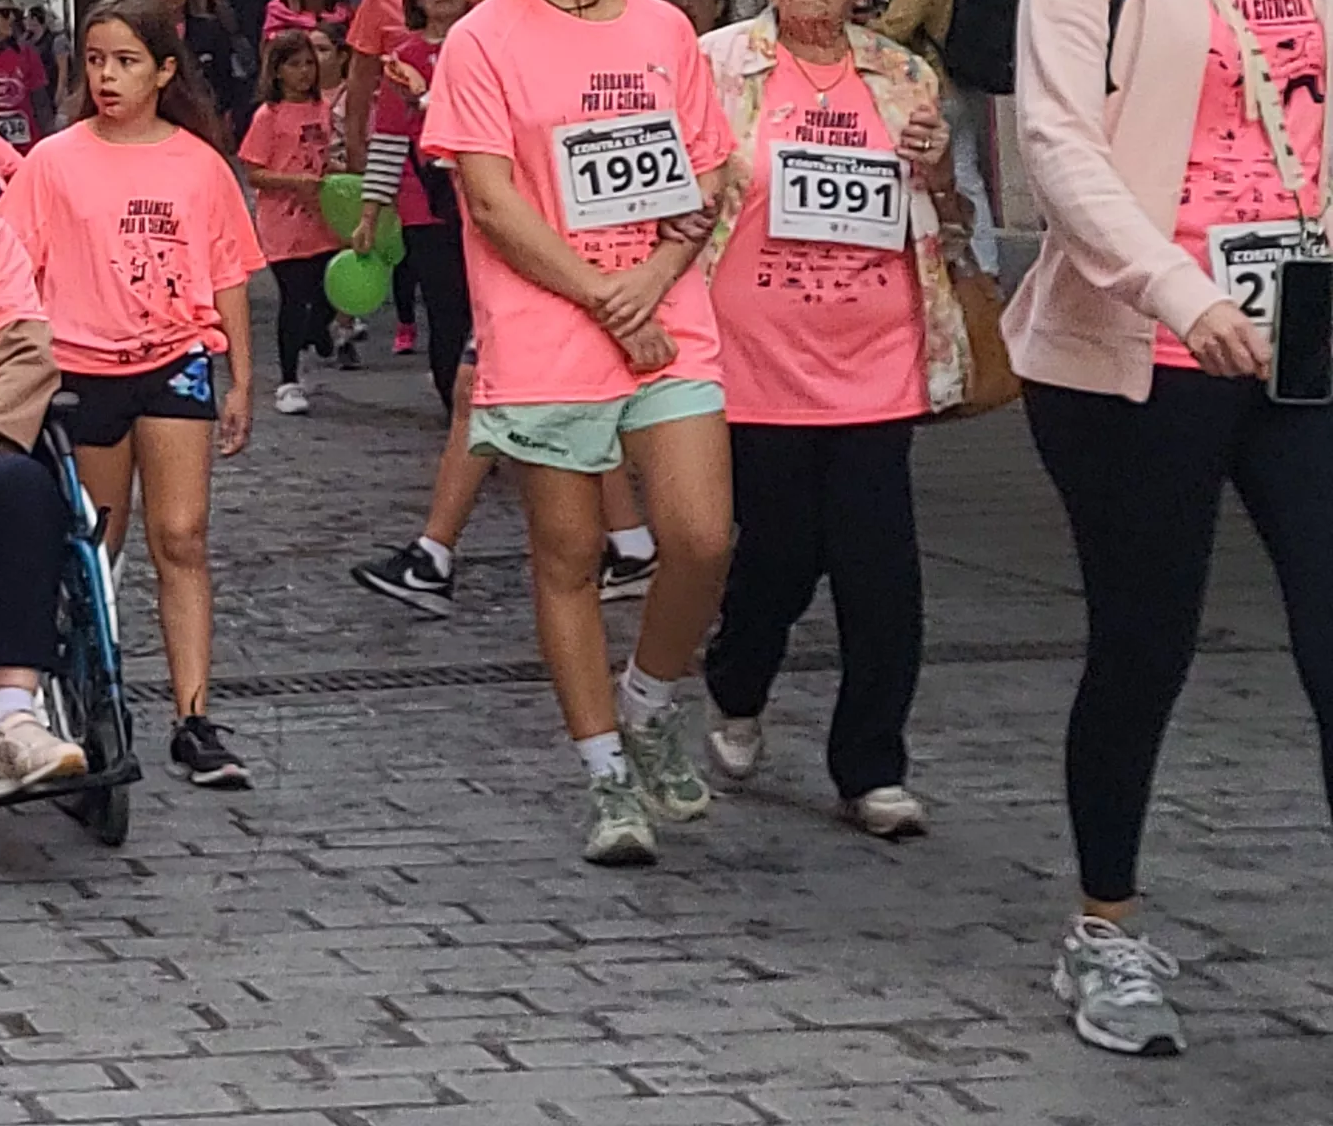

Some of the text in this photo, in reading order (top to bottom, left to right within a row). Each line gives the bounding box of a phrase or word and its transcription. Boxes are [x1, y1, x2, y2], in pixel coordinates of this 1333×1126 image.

[590, 73, 644, 91] CORRAMOS
[582, 91, 656, 112] POR LA CIENCIA
[805, 110, 859, 129] CORRAMOS
[795, 125, 868, 148] POR LA CIENCIA
[578, 146, 684, 196] 1992
[789, 175, 892, 218] 1991
[1235, 271, 1275, 318] 2
